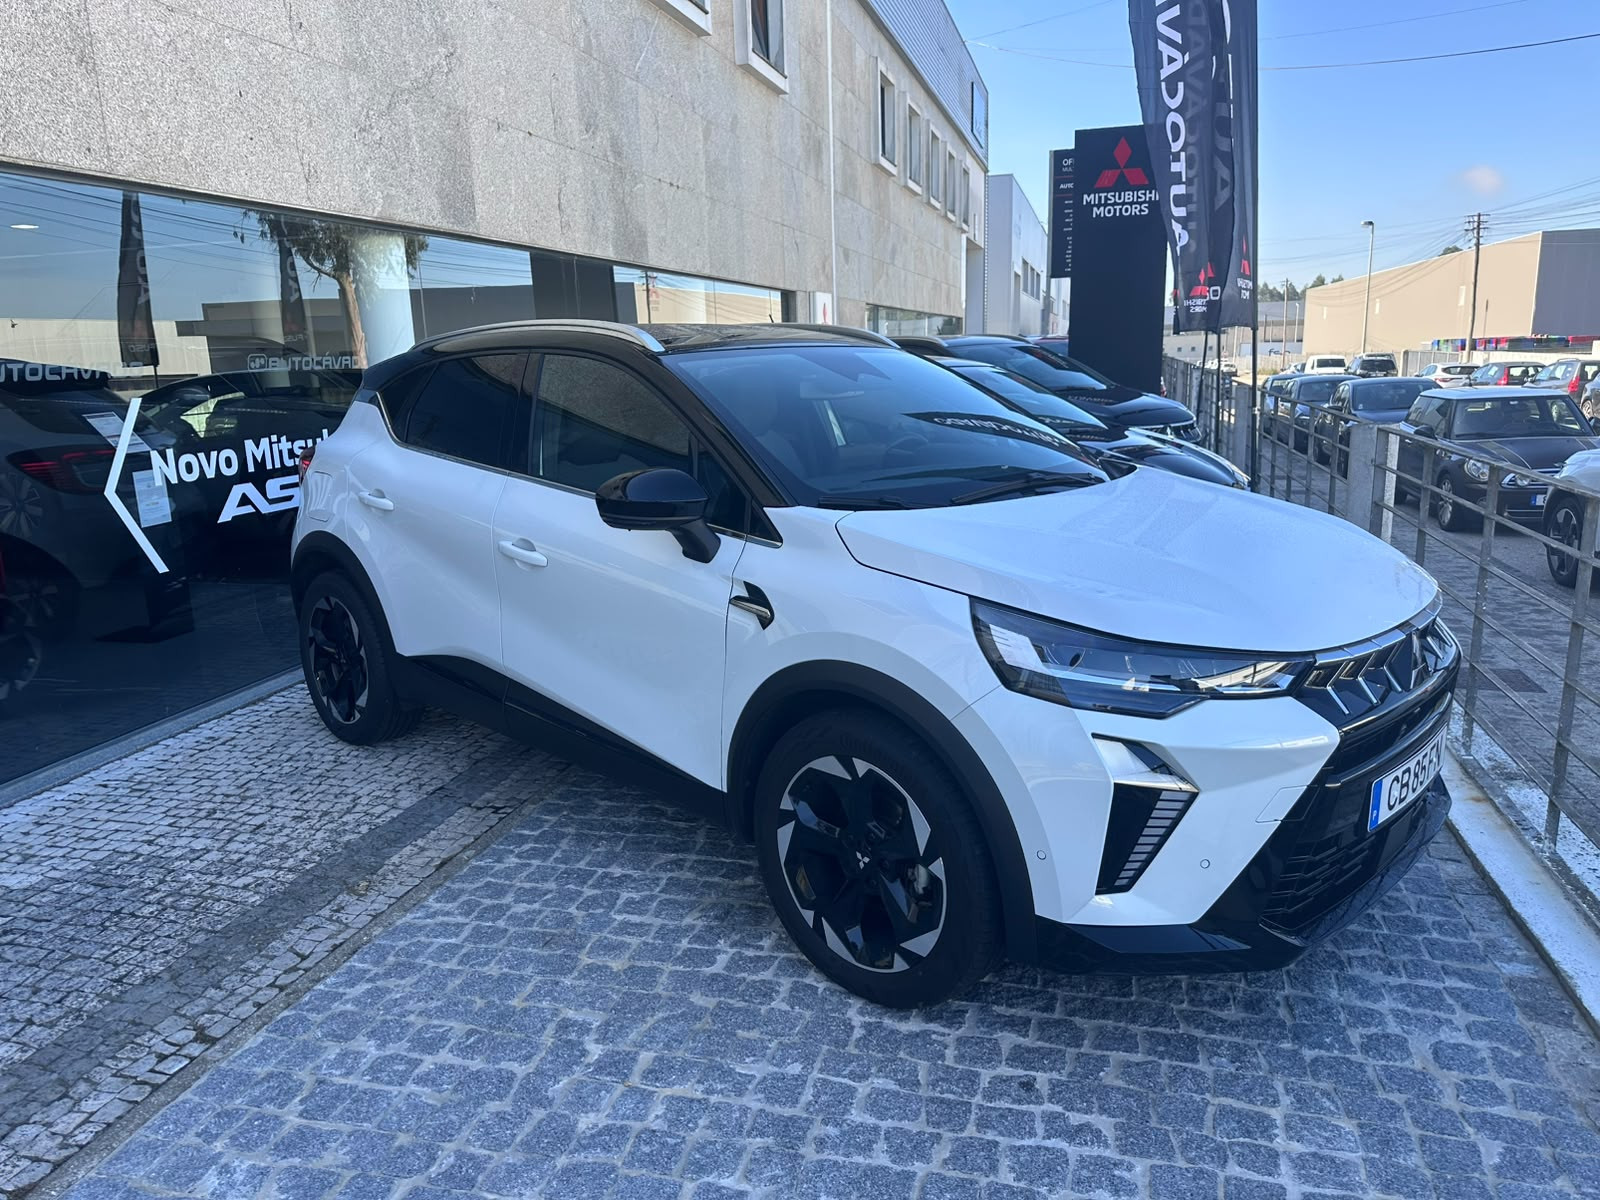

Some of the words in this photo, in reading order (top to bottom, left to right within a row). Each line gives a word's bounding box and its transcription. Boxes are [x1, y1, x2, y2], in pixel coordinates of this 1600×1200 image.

[1083, 190, 1160, 205] MITSUBISHI
[1092, 203, 1149, 218] MOTORS
[150, 448, 239, 487] Novo
[244, 429, 329, 473] Mits
[217, 475, 300, 524] AS
